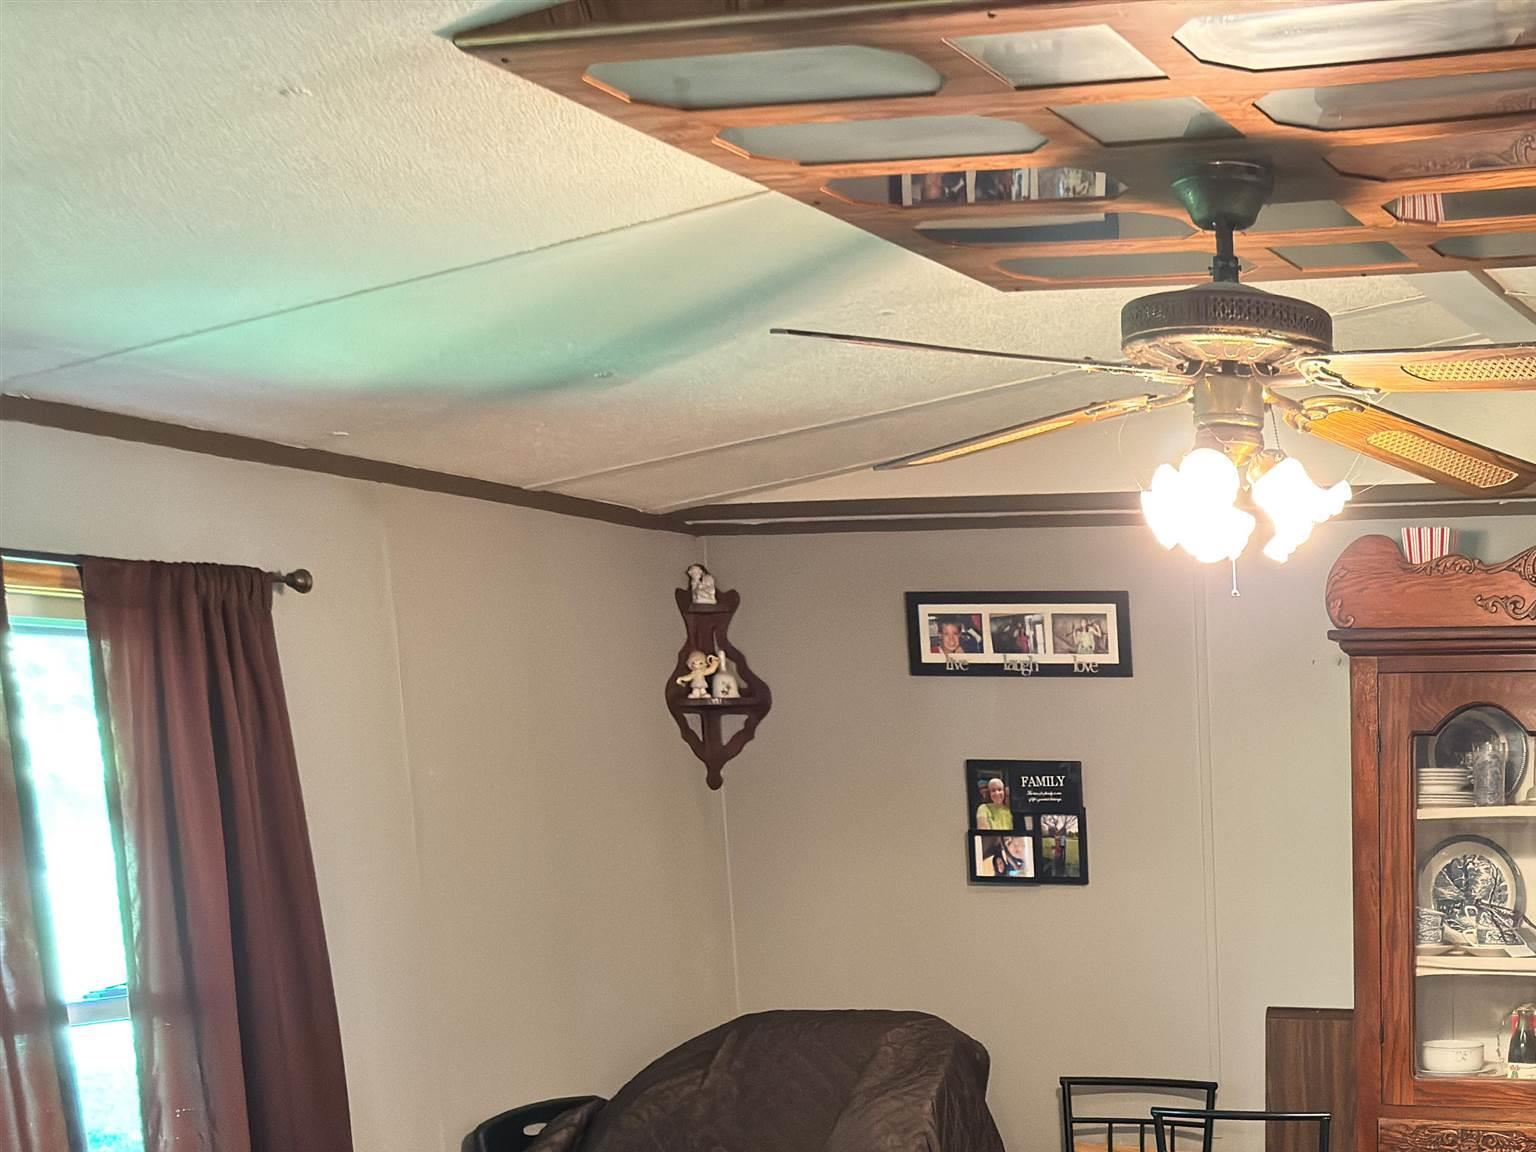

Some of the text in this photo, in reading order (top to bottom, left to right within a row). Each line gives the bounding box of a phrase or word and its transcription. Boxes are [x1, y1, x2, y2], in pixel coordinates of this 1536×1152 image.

[946, 655, 969, 671] live
[1003, 654, 1039, 676] laugh
[1073, 655, 1098, 673] love
[1021, 775, 1066, 787] FAMILY
